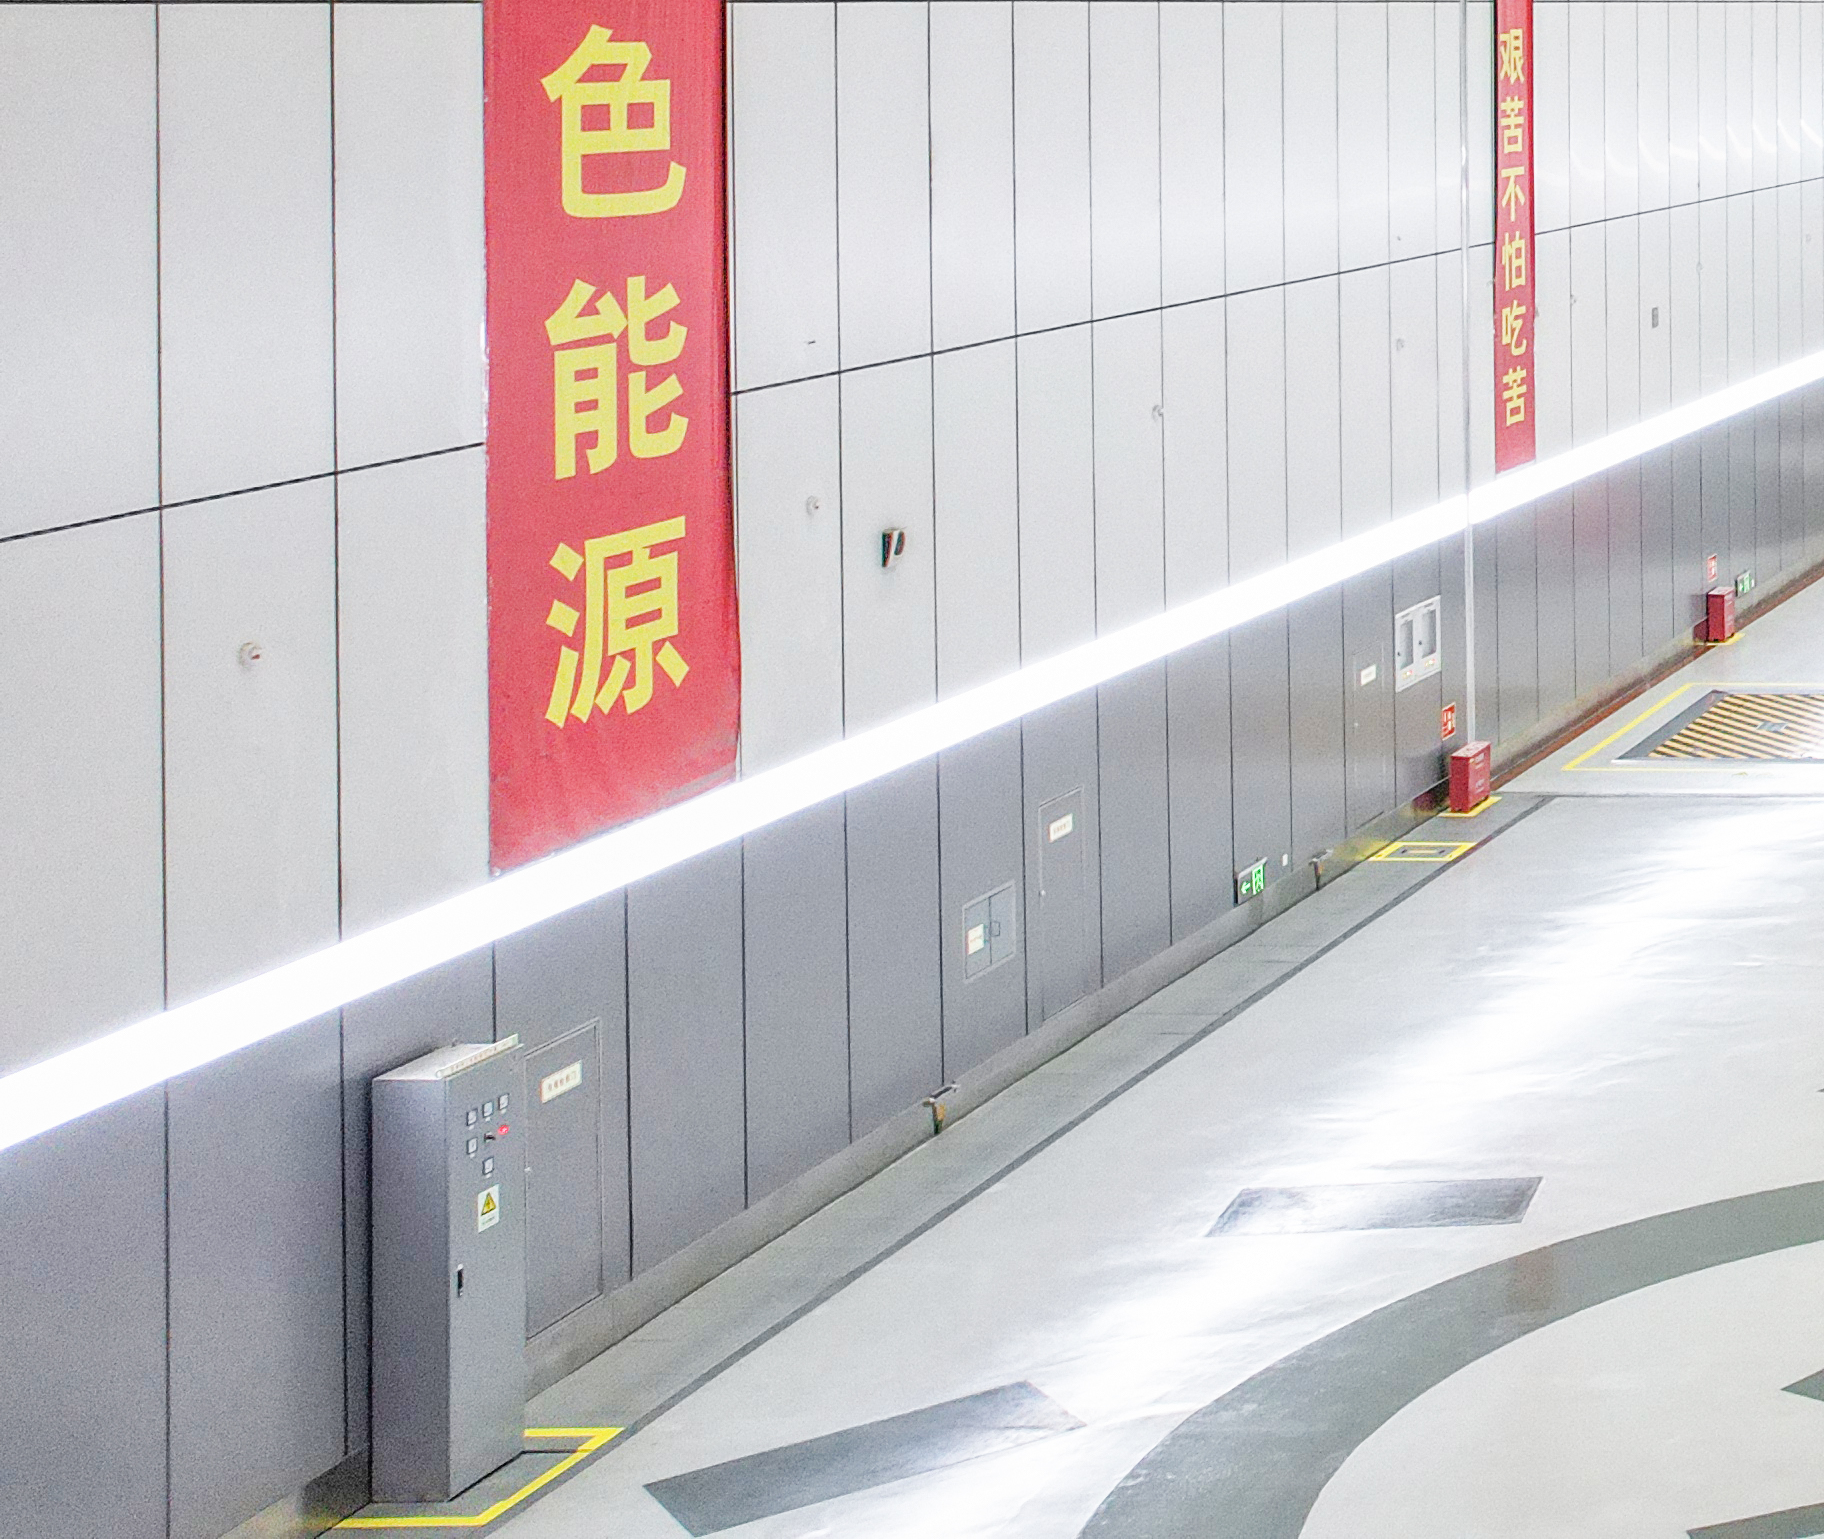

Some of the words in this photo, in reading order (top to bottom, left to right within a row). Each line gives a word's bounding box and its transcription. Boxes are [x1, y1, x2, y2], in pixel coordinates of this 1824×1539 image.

[1498, 28, 1527, 427] 艰苦不怕吃苦
